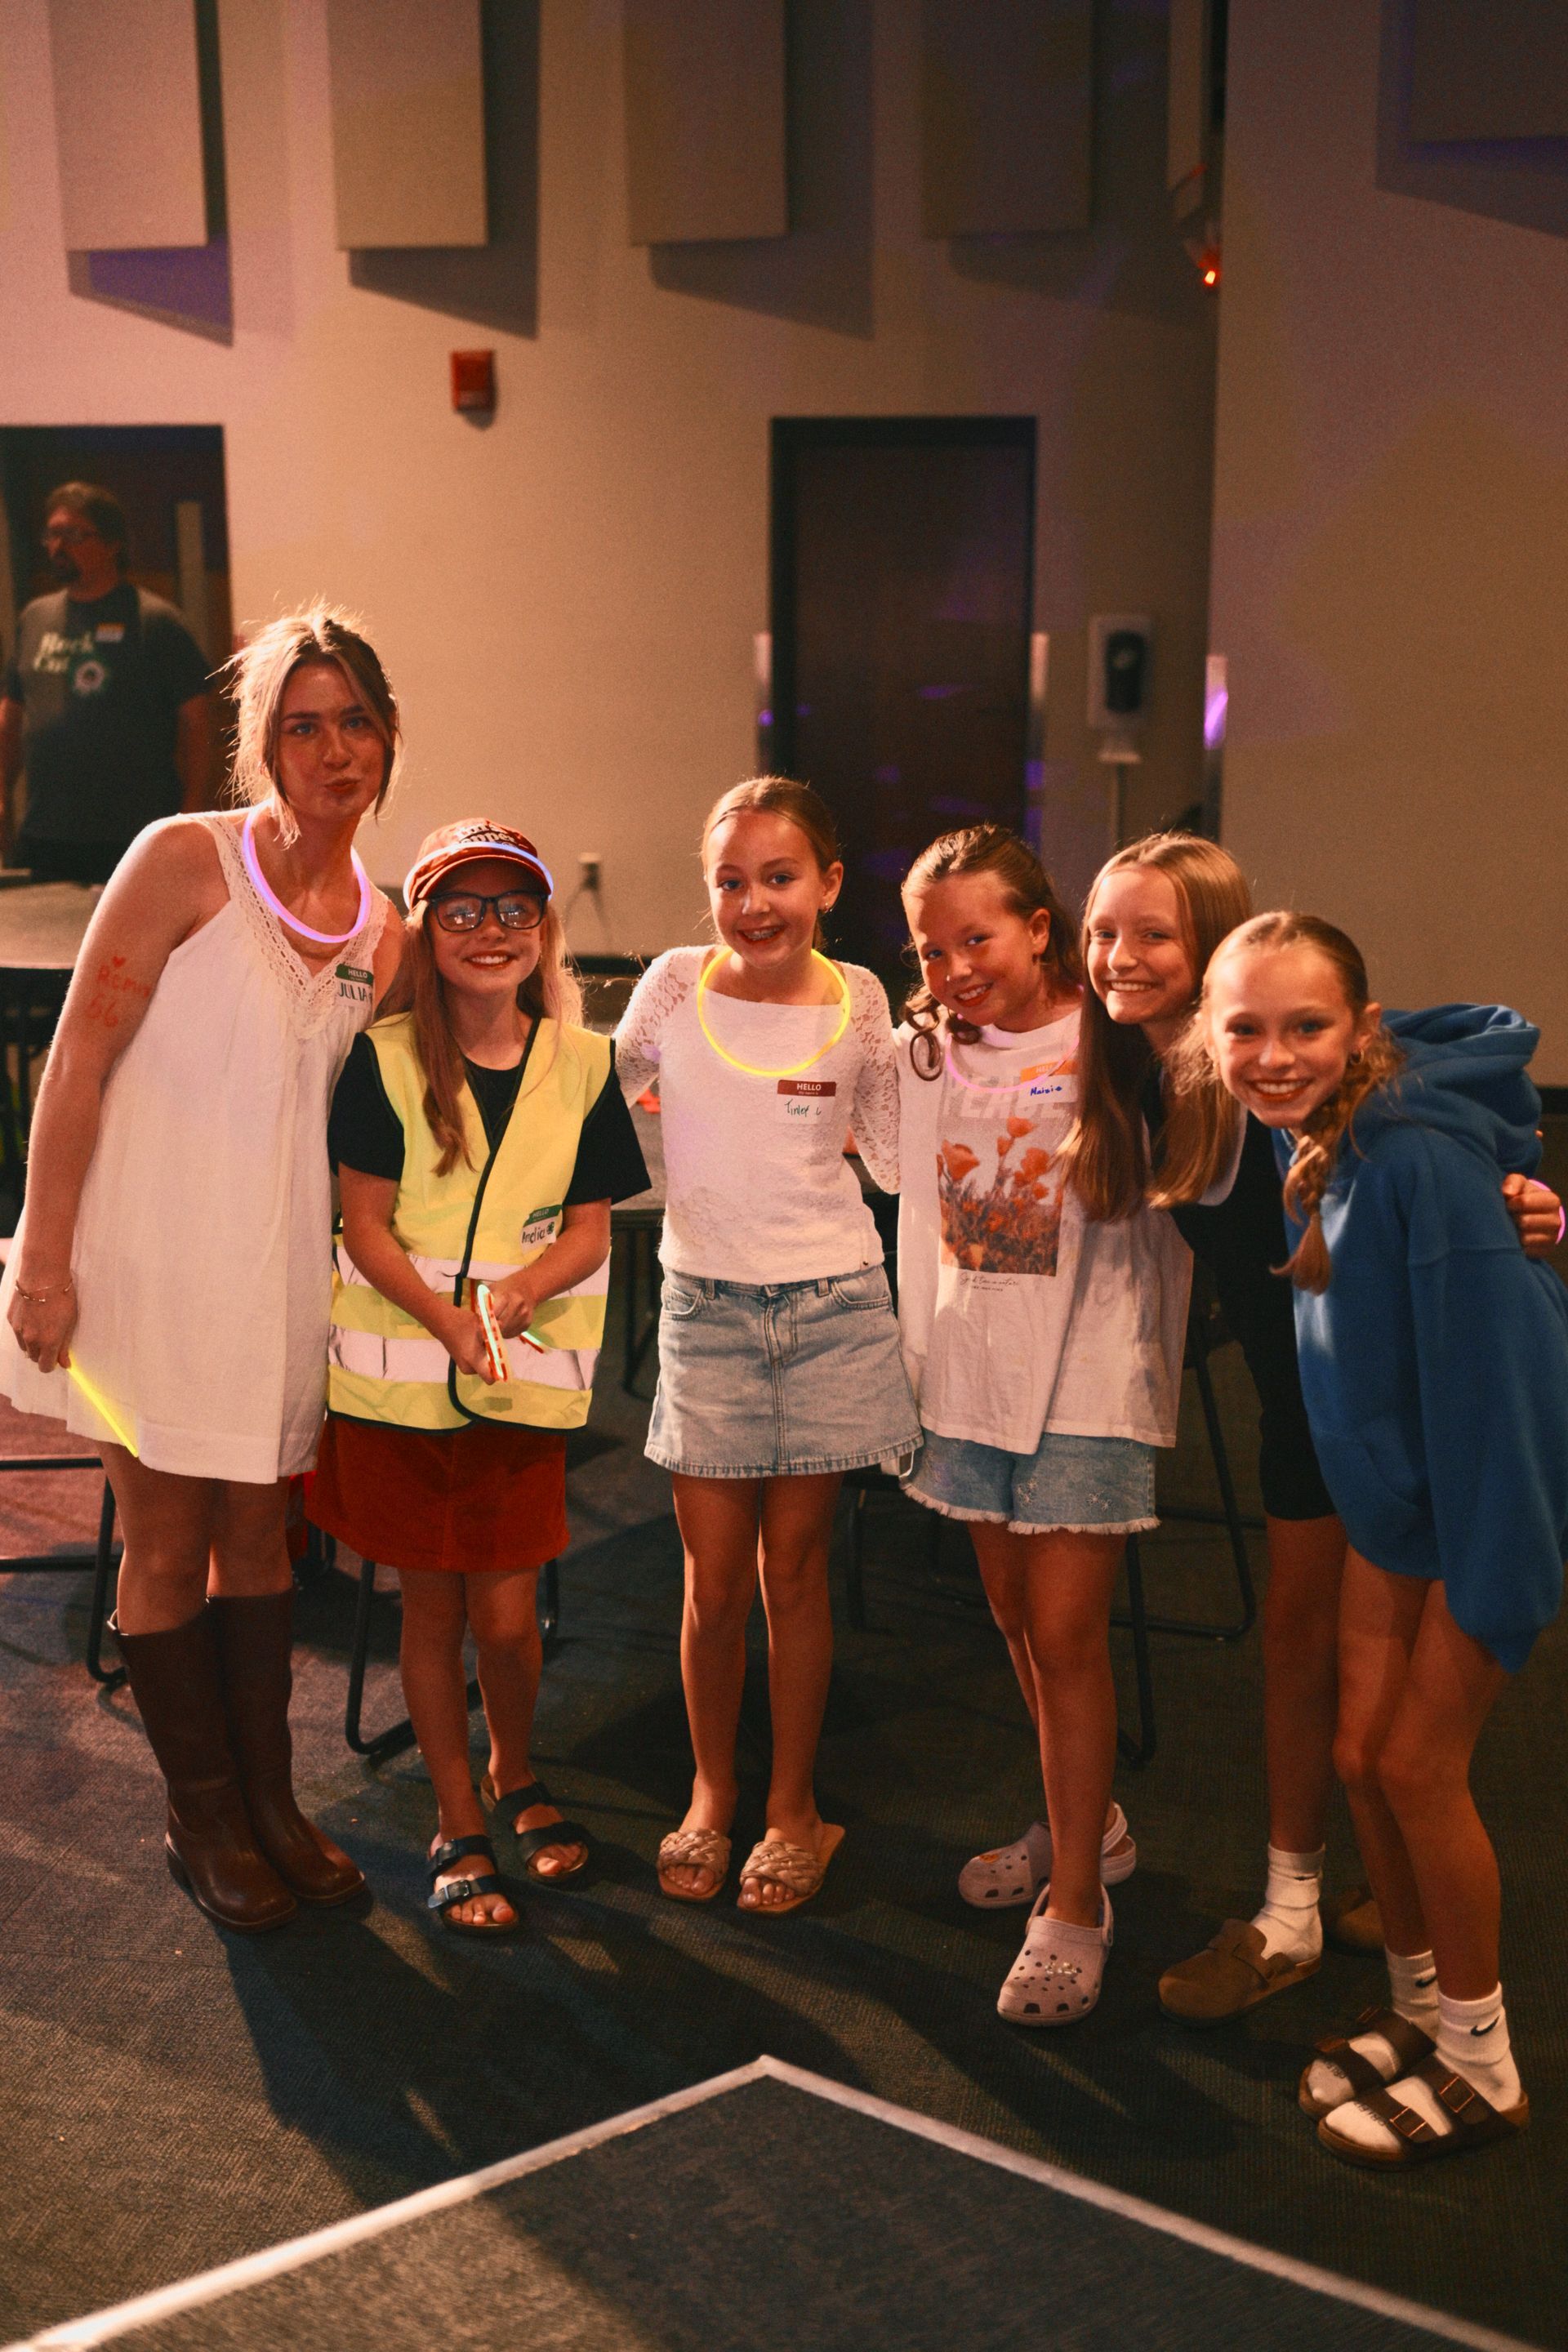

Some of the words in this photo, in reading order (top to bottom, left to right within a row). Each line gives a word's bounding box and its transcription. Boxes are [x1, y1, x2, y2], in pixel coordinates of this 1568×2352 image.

[348, 969, 368, 978] HELLO
[1036, 1063, 1055, 1073] HELL
[796, 1083, 822, 1091] HELLO
[532, 1209, 550, 1218] HELLO
